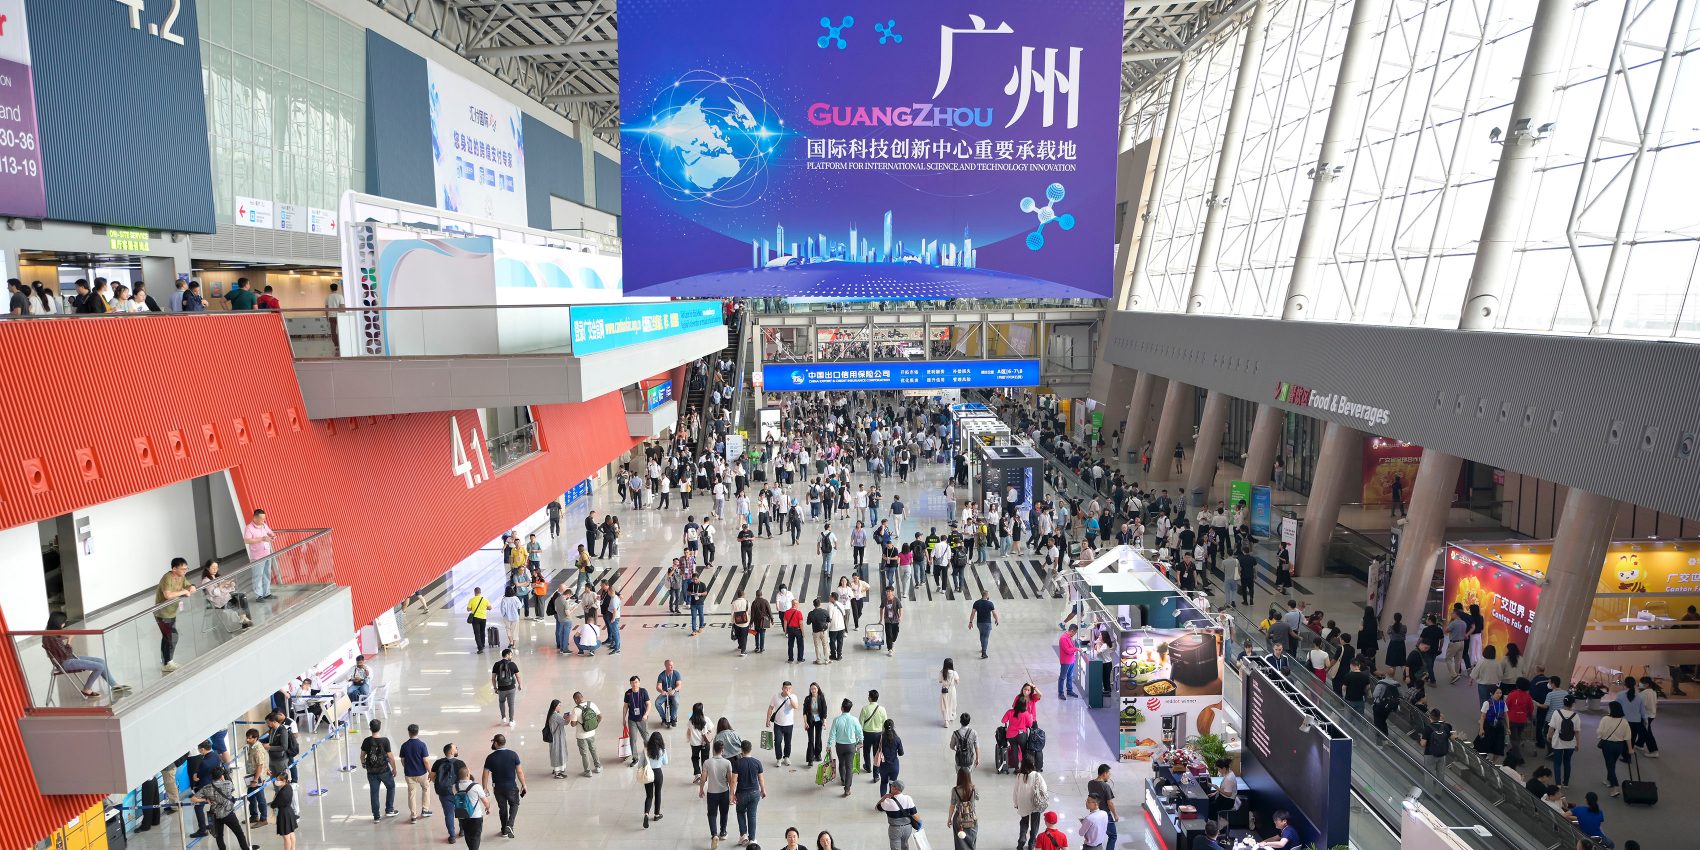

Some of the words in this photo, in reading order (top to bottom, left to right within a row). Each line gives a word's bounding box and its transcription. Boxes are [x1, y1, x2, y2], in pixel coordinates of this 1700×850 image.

[931, 14, 1083, 129] 广州
[454, 130, 513, 169] 您身边的跨境支付专家
[806, 138, 1077, 160] 国际科技创新中心重要承载地
[807, 162, 847, 170] PLATFORM
[848, 162, 864, 170] FOR
[865, 162, 925, 171] INTERNATIONAL
[926, 163, 959, 171] SCIENCE
[960, 163, 976, 171] AND
[977, 163, 1028, 171] TECHNOLOGY
[1030, 163, 1076, 172] INNOVATION
[808, 369, 891, 379] 中国出口信用保险公司
[1308, 389, 1330, 411] Food
[1330, 394, 1338, 412] &
[1338, 395, 1390, 426] Beverages
[452, 415, 489, 489] 4.1
[1493, 593, 1525, 618] 广交世界
[1491, 609, 1510, 625] Canton
[1511, 618, 1523, 630] Fair
